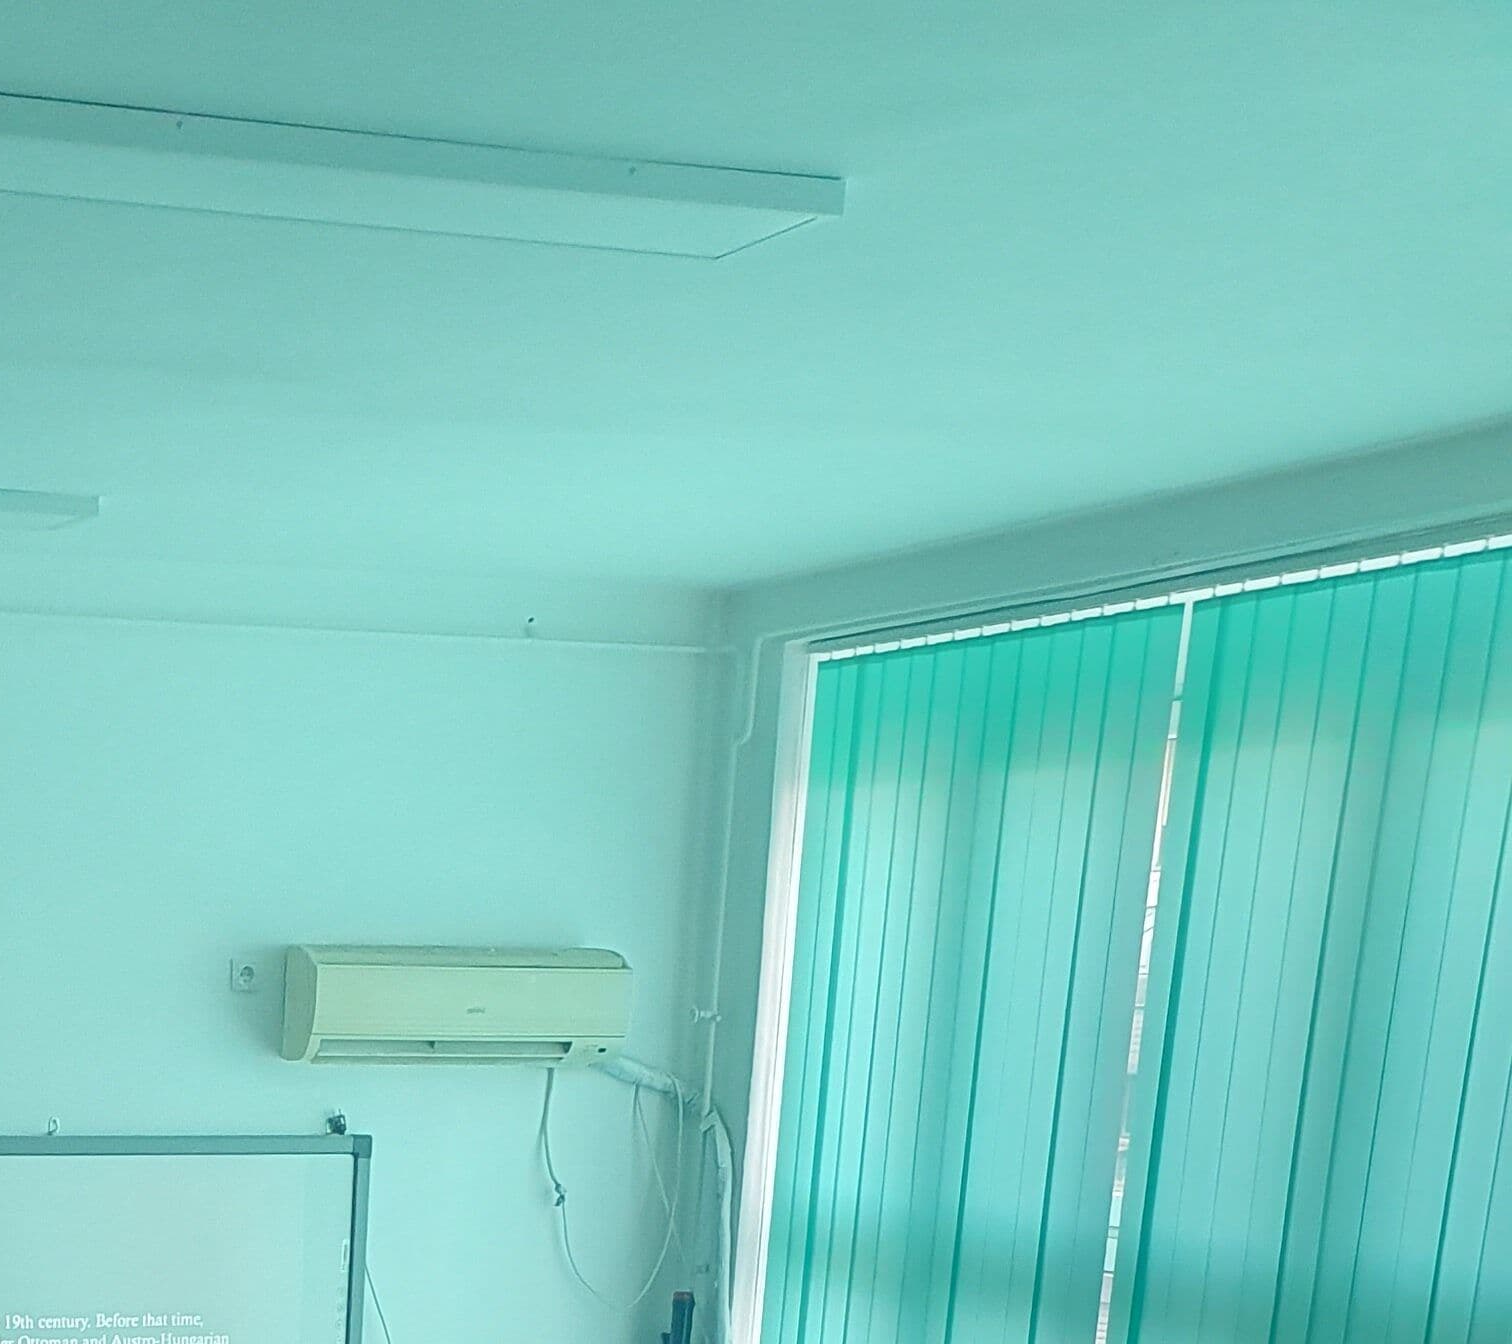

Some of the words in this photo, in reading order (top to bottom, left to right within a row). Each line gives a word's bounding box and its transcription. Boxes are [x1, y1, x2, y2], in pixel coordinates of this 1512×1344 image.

[5, 1314, 33, 1330] 19th
[38, 1317, 91, 1332] century.
[96, 1313, 139, 1328] Before
[142, 1313, 167, 1327] that
[171, 1312, 204, 1328] time,
